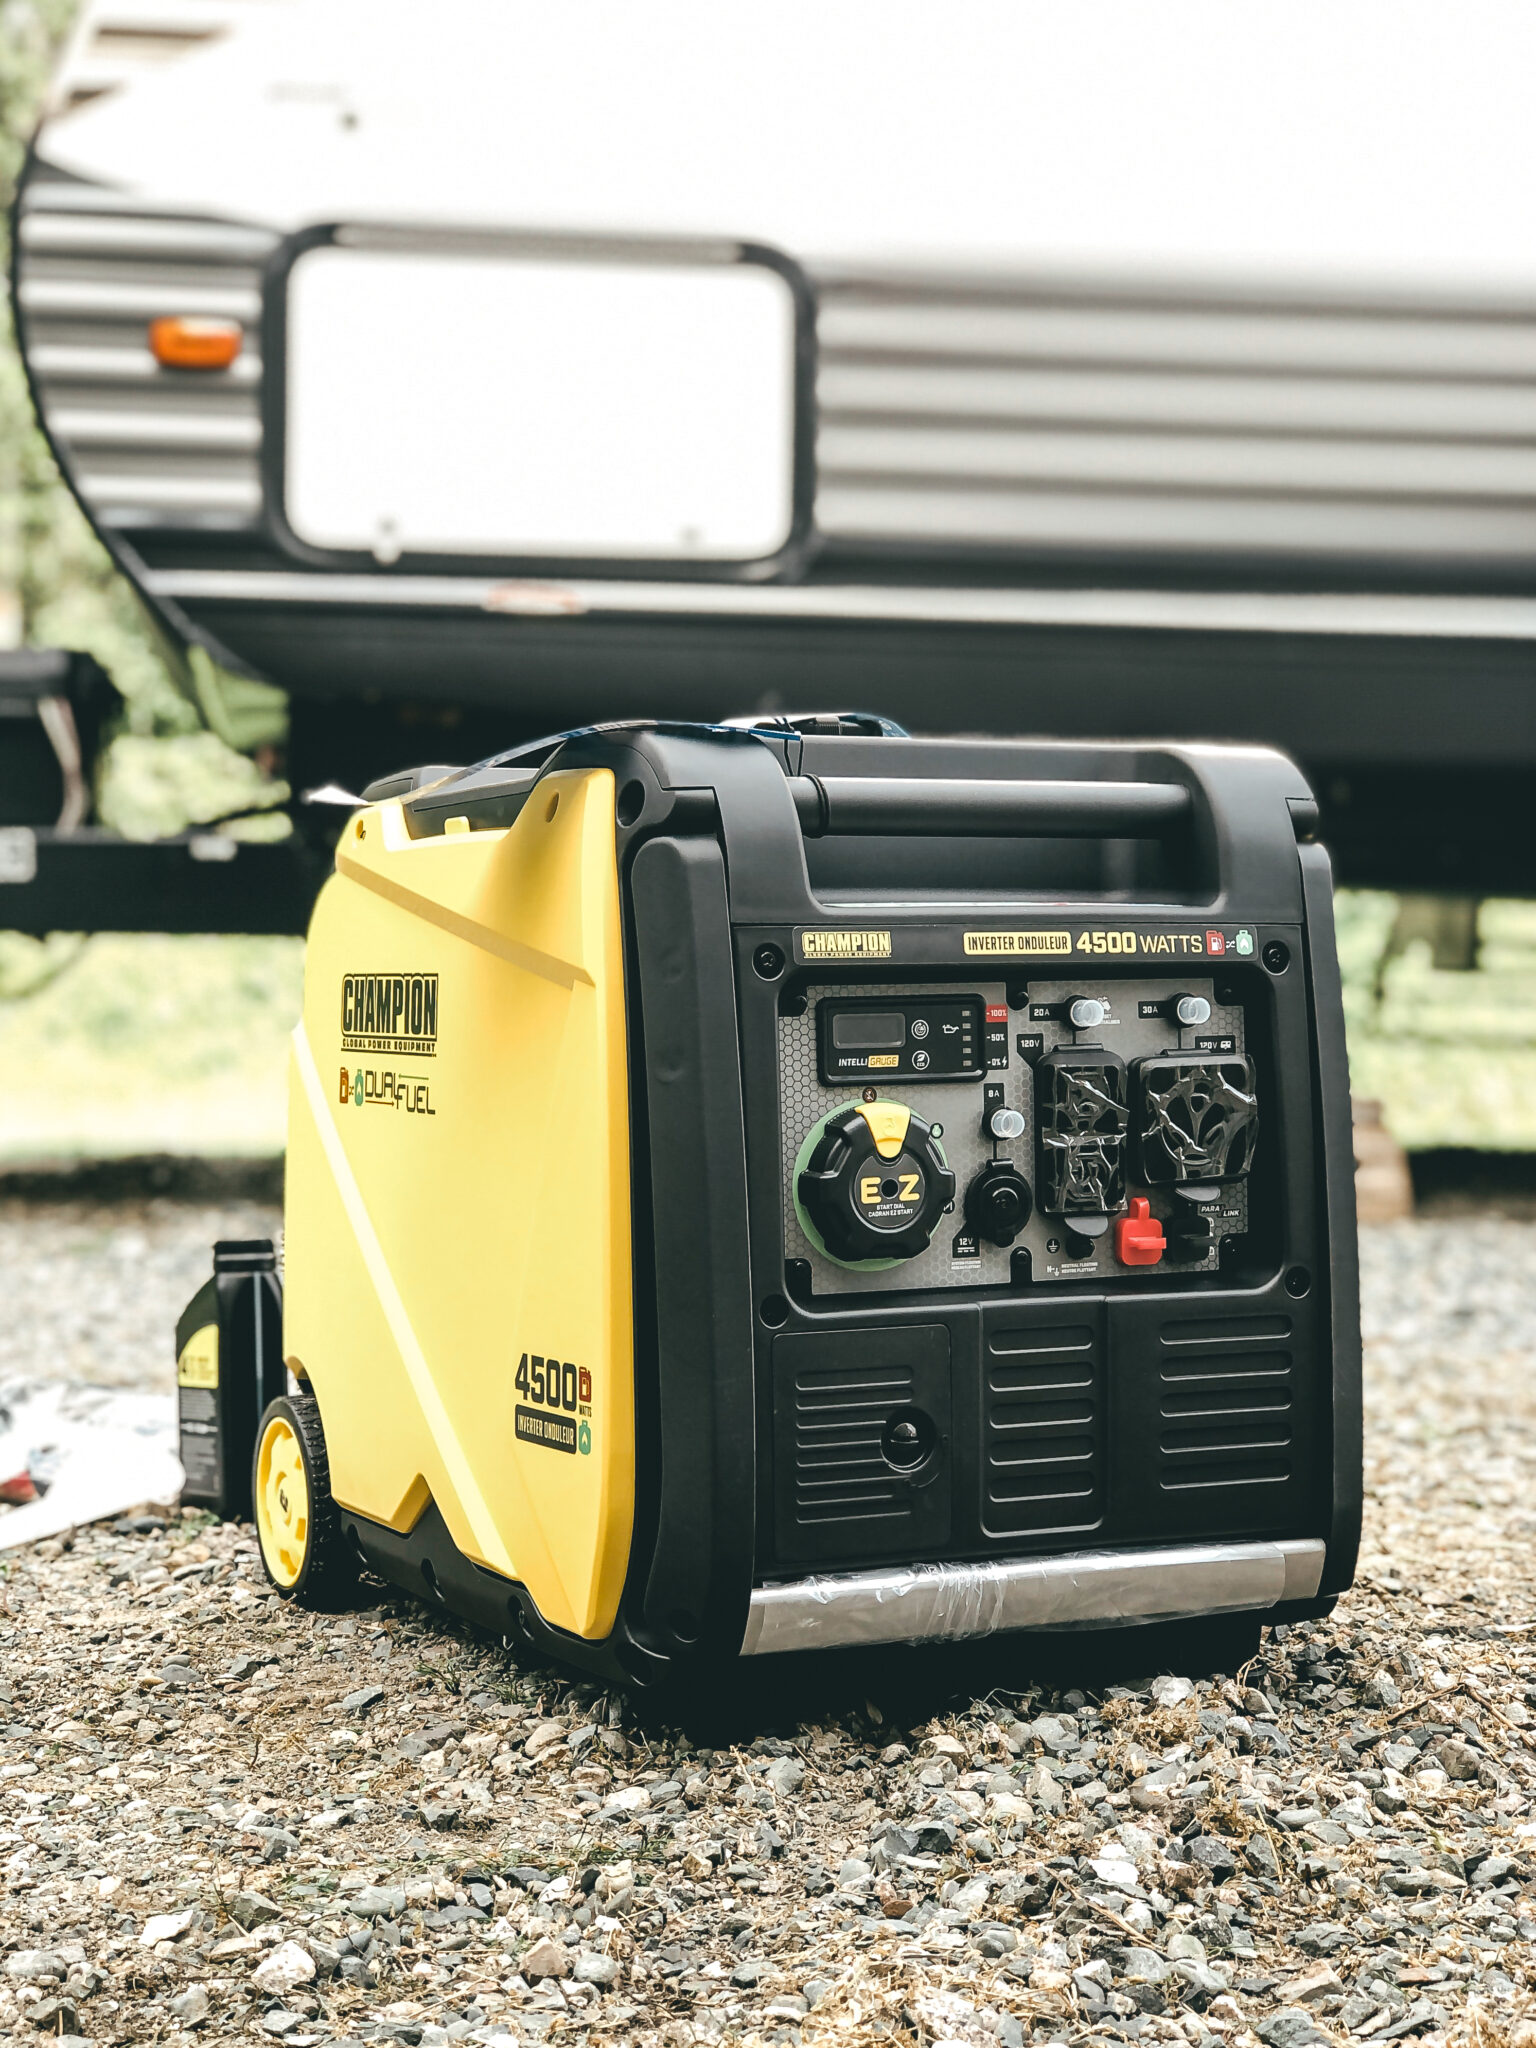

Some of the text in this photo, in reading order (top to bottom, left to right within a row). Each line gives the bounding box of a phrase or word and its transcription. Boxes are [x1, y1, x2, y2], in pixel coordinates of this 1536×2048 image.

[803, 932, 890, 952] CHAMPION
[968, 931, 1203, 954] INVERTER ONDULEUR 4500 WATTS
[342, 977, 437, 1037] CHAMPION
[342, 1038, 436, 1053] GLOBAL POWER EQUIPMENT
[1020, 1039, 1040, 1048] 120V
[838, 1056, 897, 1067] INTELLI GAUGE
[365, 1070, 403, 1100] DUAL
[396, 1084, 436, 1115] FUEL
[876, 1203, 893, 1211] START
[1201, 1205, 1240, 1217] PARA LINK
[959, 1237, 973, 1246] 12V
[514, 1352, 577, 1412] 4500
[517, 1413, 574, 1446] INVERTER ONDULEUR
